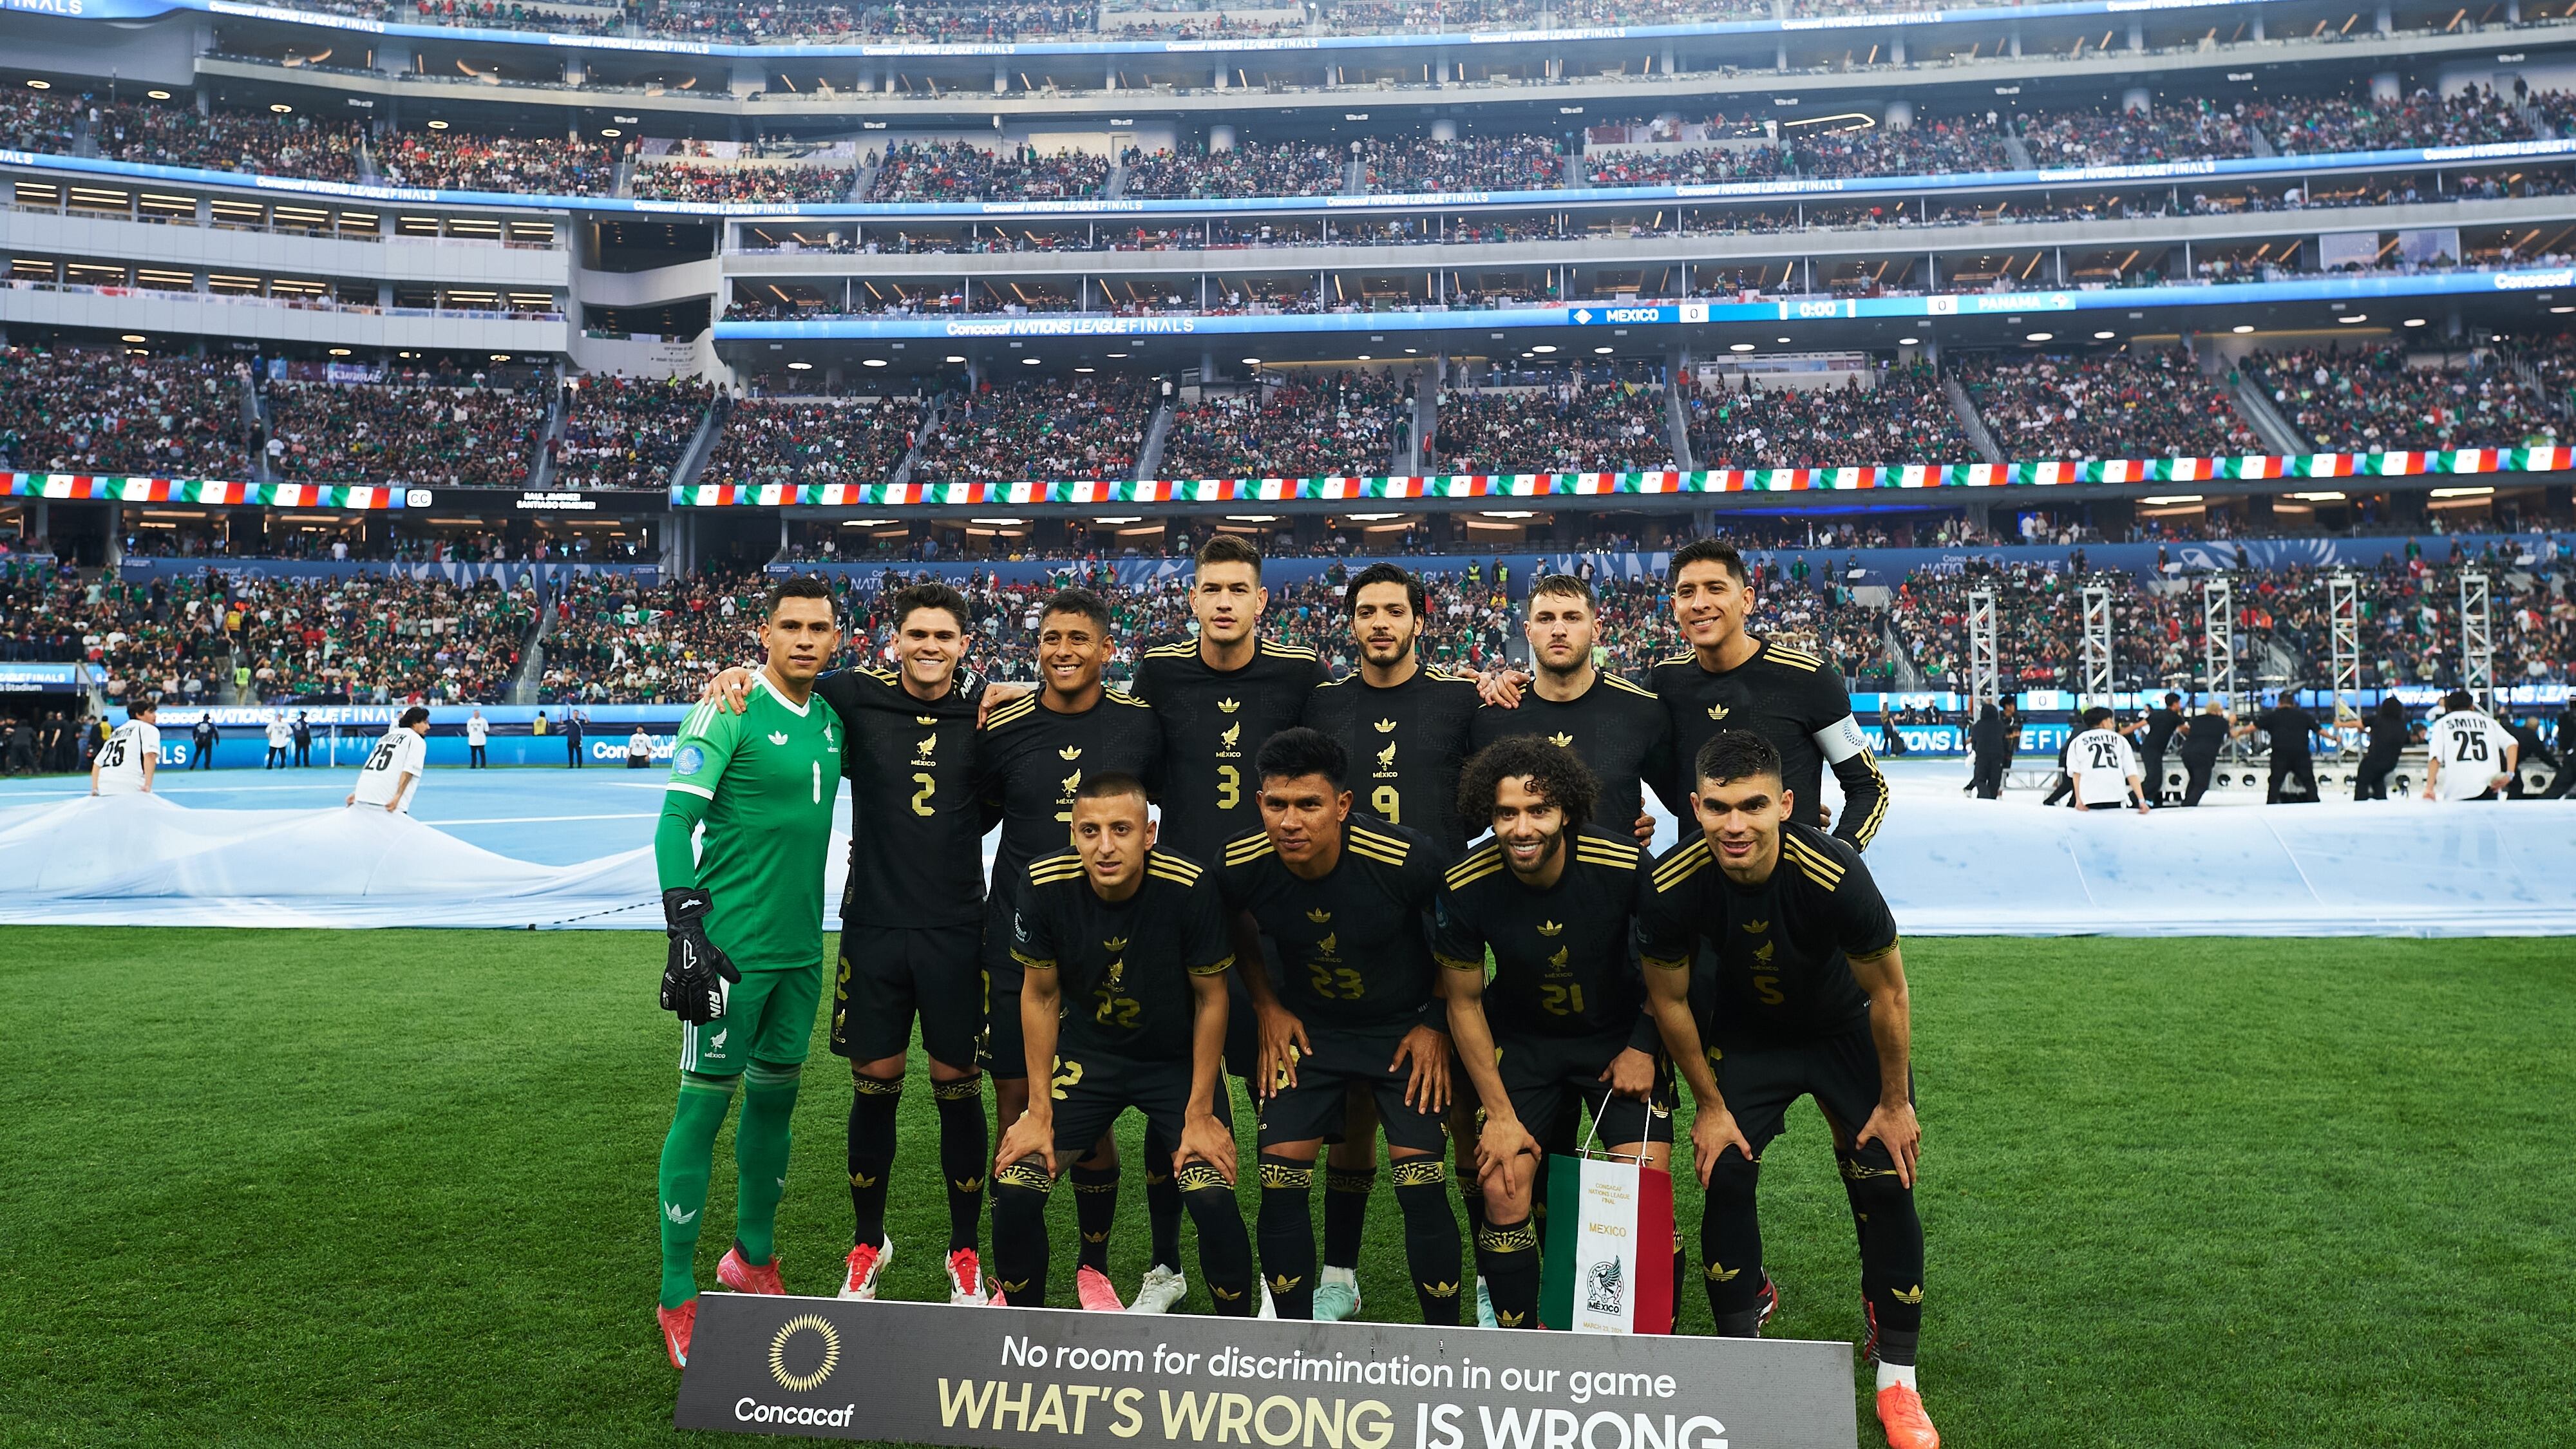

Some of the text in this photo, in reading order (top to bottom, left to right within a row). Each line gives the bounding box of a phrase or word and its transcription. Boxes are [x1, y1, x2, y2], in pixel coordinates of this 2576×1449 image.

[0, 0, 82, 14] INALS
[339, 17, 384, 33] FINALS
[1900, 12, 1942, 24] FINALS
[1583, 27, 1625, 38] FINALS
[667, 41, 710, 53] FINALS
[974, 44, 1016, 54] FINALS
[1277, 39, 1319, 49] FINALS
[2167, 161, 2215, 175] FINALS
[1798, 179, 1843, 191] FINALS
[390, 187, 437, 201] FINALS
[1445, 192, 1489, 202] FINALS
[755, 203, 799, 214] FINALS
[1101, 200, 1143, 211] FINALS
[2494, 270, 2573, 290] Concacaf
[1799, 302, 1835, 317] 0:00
[1938, 301, 1946, 310] 0
[1978, 296, 2041, 310] PANAMA
[1606, 308, 1659, 322] MEXICO
[1690, 308, 1698, 319] 0
[946, 318, 1194, 335] Concacaf NATIONS LEAGUE FINALS
[411, 494, 428, 504] CC
[5, 683, 43, 692] Stadium
[2039, 696, 2047, 706] 0
[341, 708, 410, 722] FINAL
[2446, 718, 2486, 729] SMITH
[2082, 735, 2117, 745] SMITH
[2453, 731, 2488, 761] 25
[103, 739, 127, 767] 25
[365, 743, 396, 771] 25
[592, 741, 676, 759] Concaf
[2088, 743, 2118, 769] 25
[812, 760, 820, 804] 1
[1217, 765, 1240, 809] 3
[912, 773, 935, 816] 2
[1372, 785, 1399, 824] 9
[1307, 963, 1365, 999] 23
[1754, 976, 1785, 1005] 5
[1540, 983, 1585, 1015] 21
[1094, 990, 1142, 1028] 22
[1052, 1055, 1083, 1100] 2
[1589, 1222, 1627, 1237] MEXICO
[1589, 1301, 1619, 1313] MÉXICO
[1001, 1335, 1676, 1404] No room for discrimination in our game
[735, 1397, 855, 1427] Concacaf
[938, 1378, 1728, 1449] WHAT'S WRONG IS WRONG
